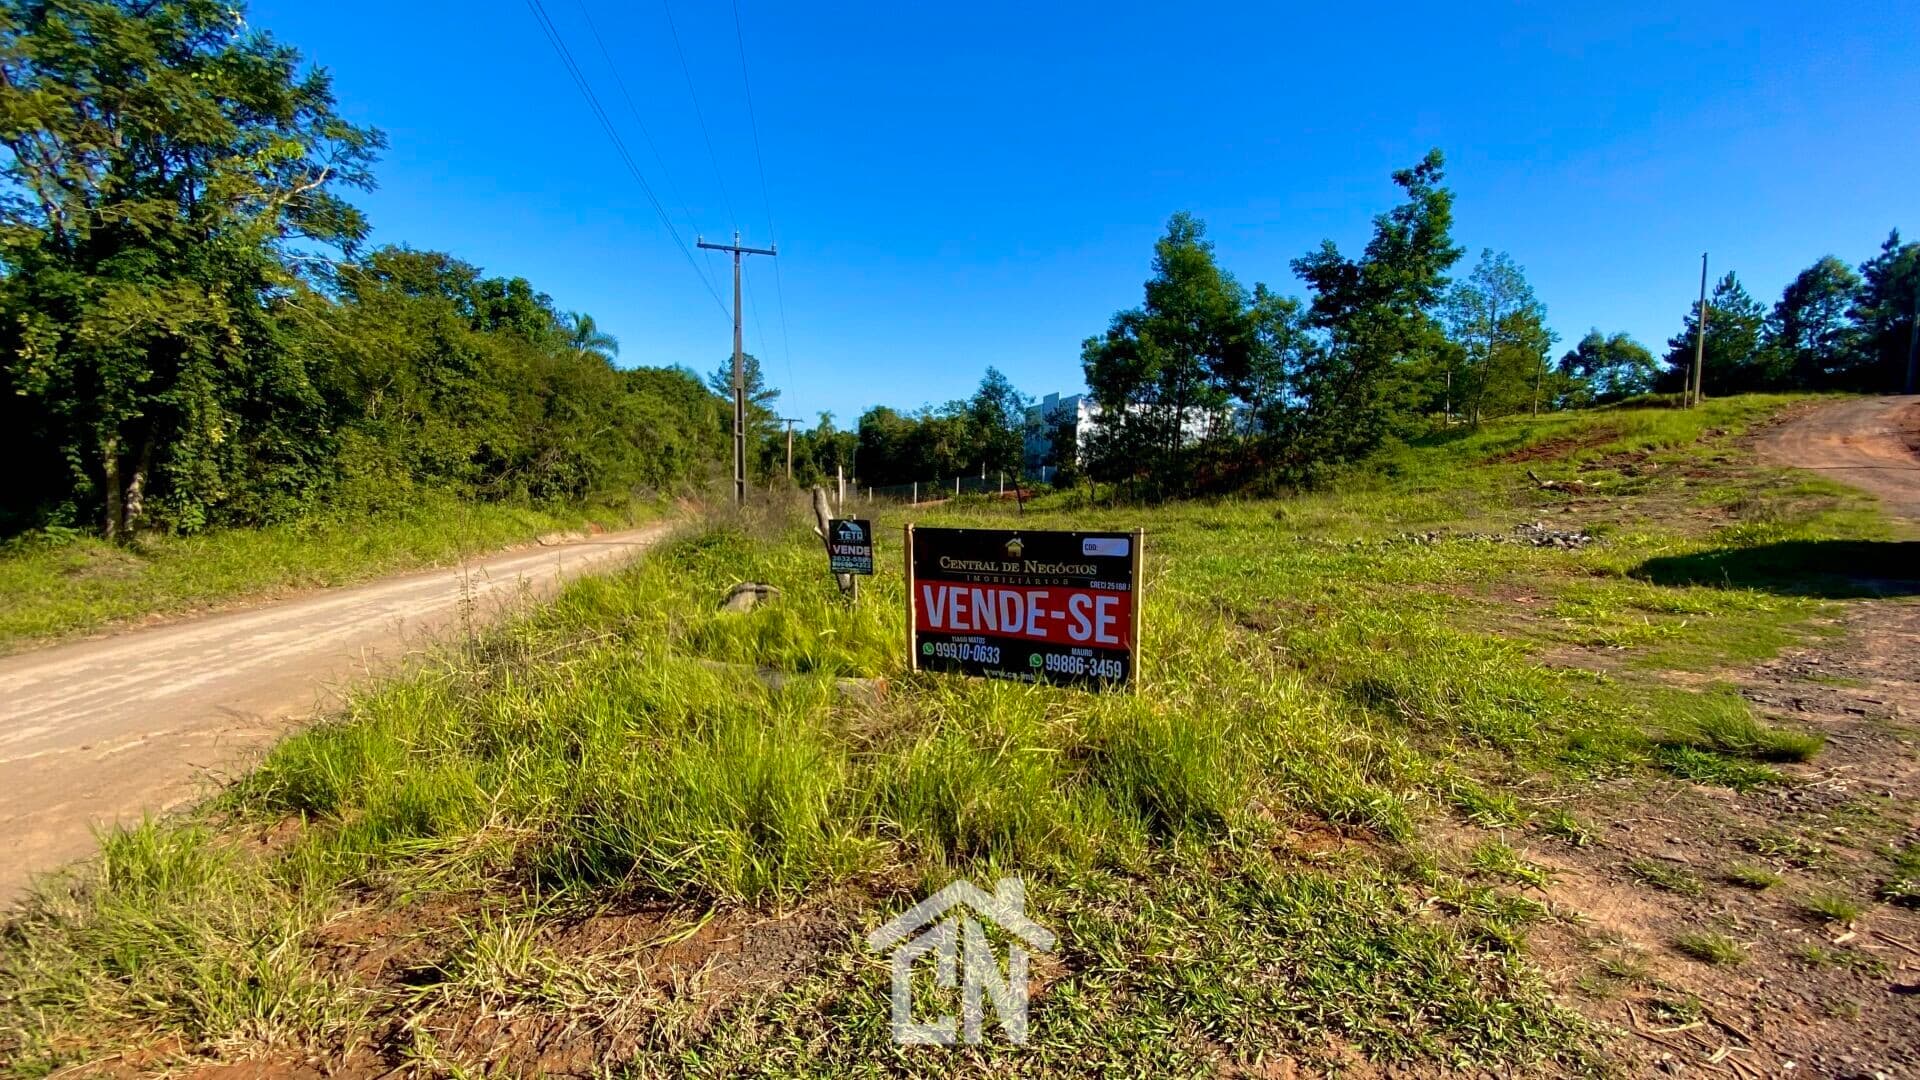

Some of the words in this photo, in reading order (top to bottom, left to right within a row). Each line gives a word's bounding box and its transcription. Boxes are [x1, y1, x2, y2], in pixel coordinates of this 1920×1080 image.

[832, 544, 871, 556] VENDE
[939, 556, 998, 572] CENTRAL
[1002, 562, 1020, 573] DE
[1024, 560, 1097, 576] NEGÓCIOS
[1090, 581, 1106, 589] CRECI
[923, 585, 1119, 645] VENDE-SE
[936, 642, 1000, 664] 99910-0633
[1071, 647, 1093, 657] MAURO
[1045, 652, 1122, 679] 99886-3459
